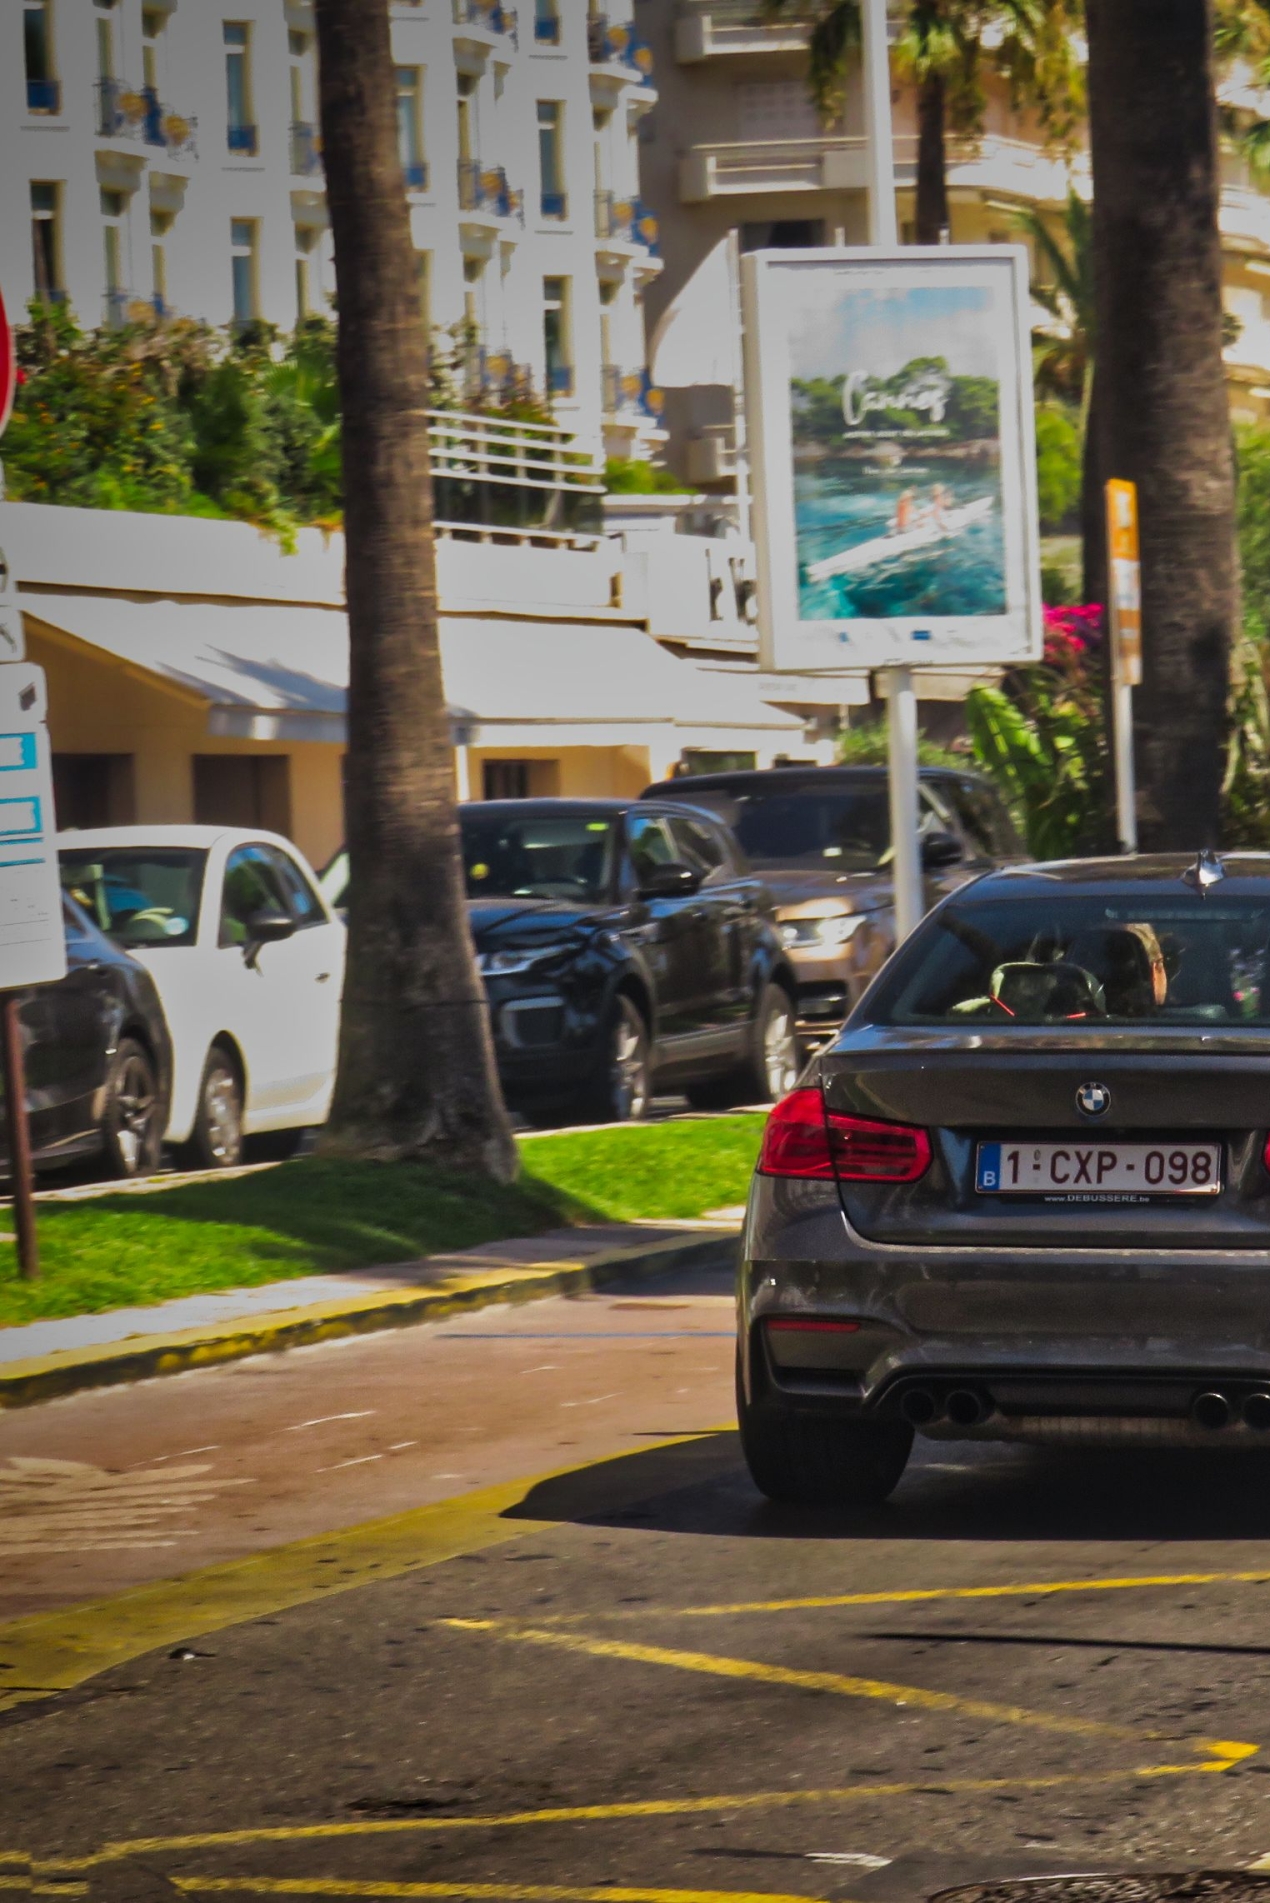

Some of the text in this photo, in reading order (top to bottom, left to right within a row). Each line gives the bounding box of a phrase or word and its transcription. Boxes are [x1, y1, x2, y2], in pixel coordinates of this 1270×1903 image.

[983, 1150, 1212, 1186] B 1-CXP-098
[1044, 1194, 1150, 1203] www.DEBUSSERE.be
